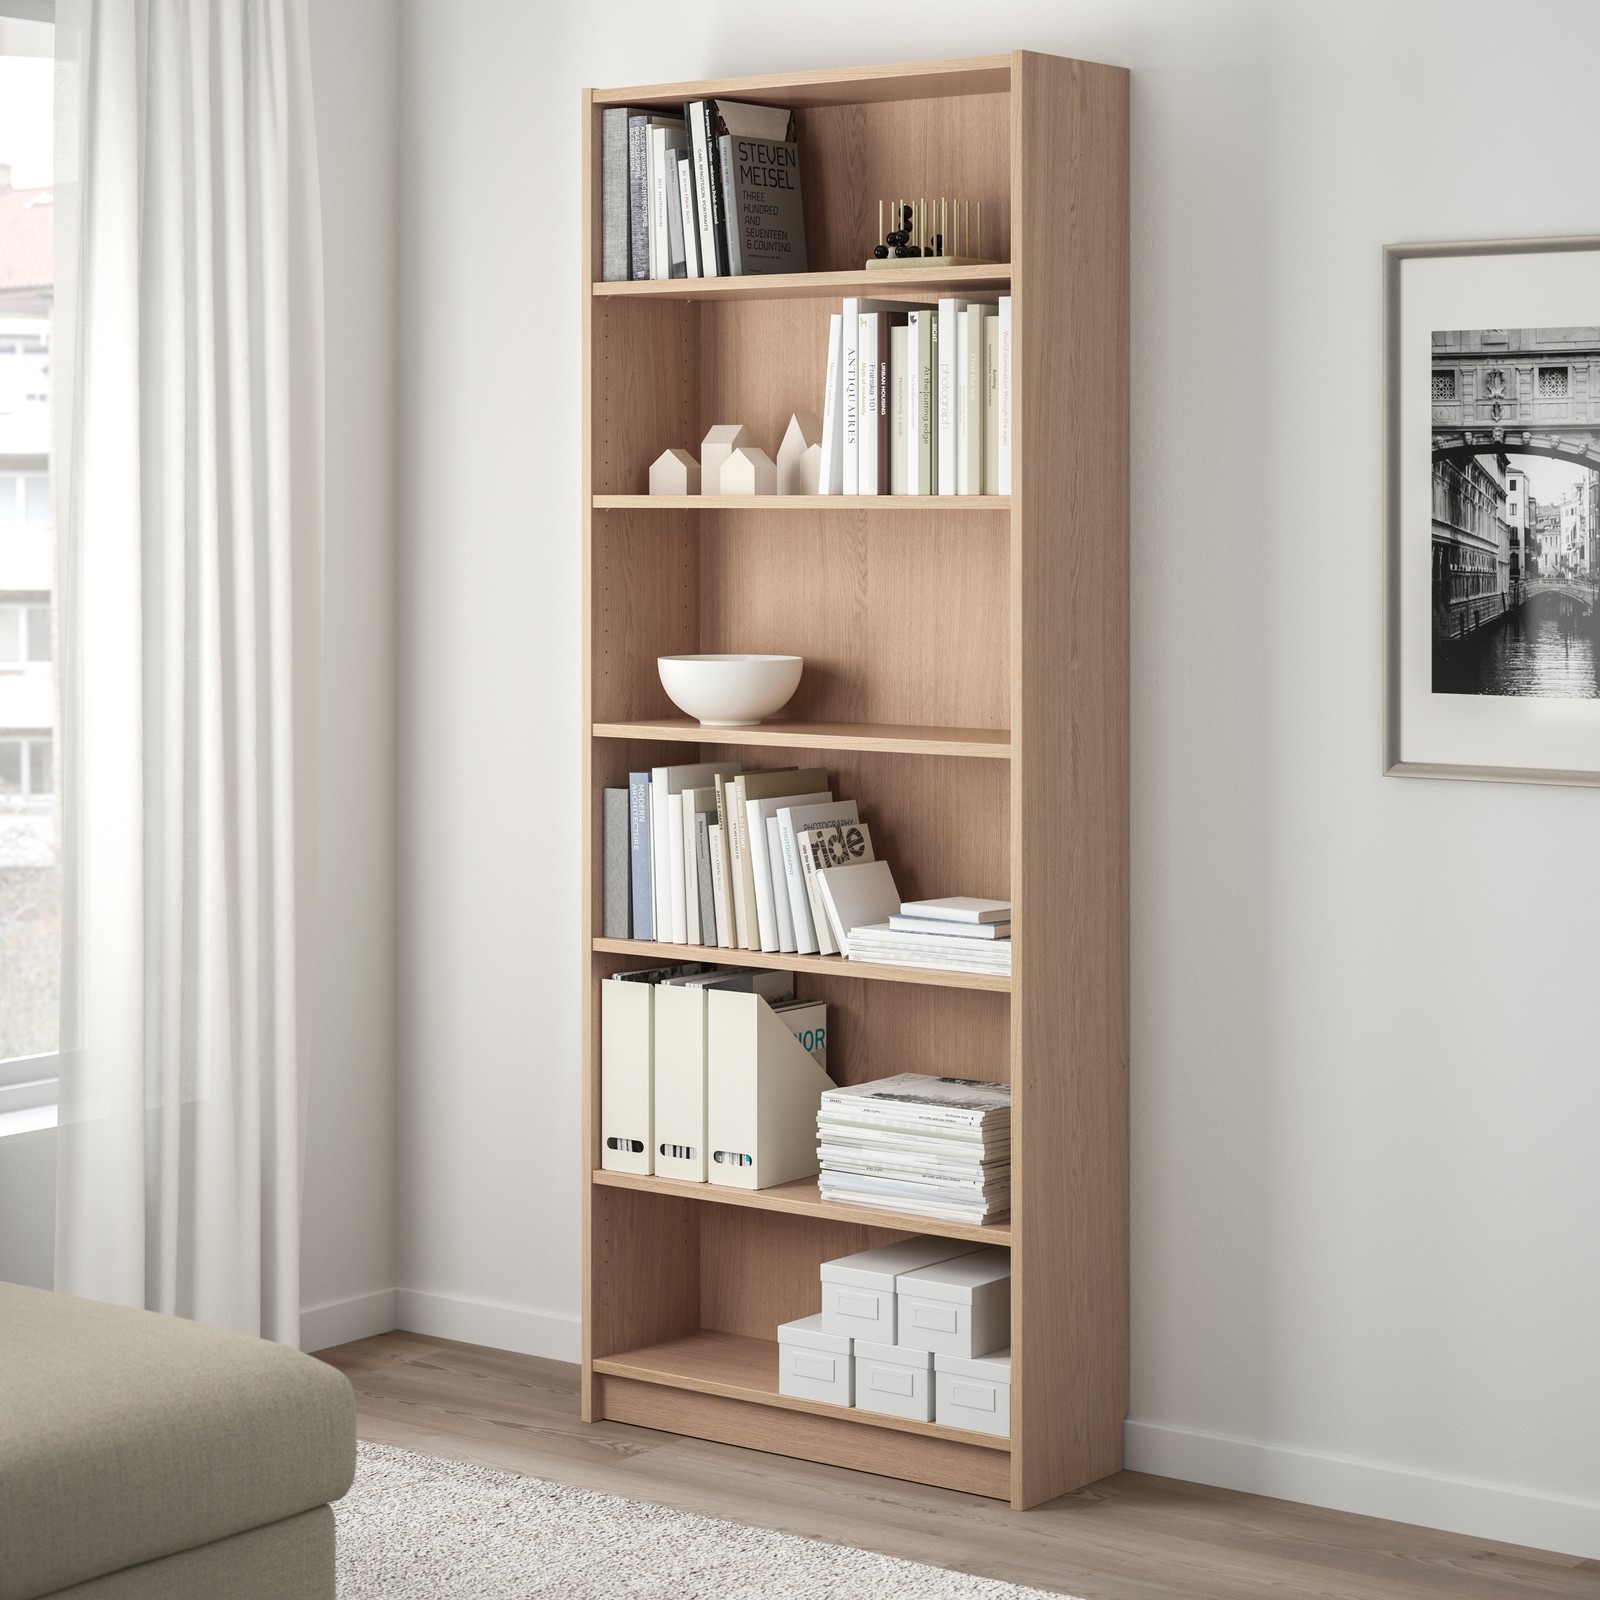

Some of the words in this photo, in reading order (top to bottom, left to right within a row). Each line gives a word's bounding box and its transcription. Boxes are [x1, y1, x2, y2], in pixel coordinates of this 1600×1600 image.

[738, 142, 796, 168] STEVEN
[698, 164, 706, 198] BENGTSSON
[740, 164, 795, 190] MEISEL
[742, 191, 765, 202] THREE
[744, 204, 779, 216] HUNDRED
[744, 215, 761, 227] AND
[745, 228, 788, 240] SEVENTEEN
[747, 240, 753, 250] &
[753, 241, 791, 253] COUNTING
[923, 366, 930, 376] At
[846, 348, 856, 444] ANTIQUAIRES
[922, 394, 930, 422] cutting
[940, 363, 950, 430] photograph
[1001, 391, 1009, 417] through
[922, 423, 930, 445] edge
[632, 783, 640, 851] ARCHITECTURE
[803, 818, 854, 831] PHOTOGRAPHY
[782, 827, 794, 876] PHOTOGRAPHY
[811, 826, 865, 870] ride
